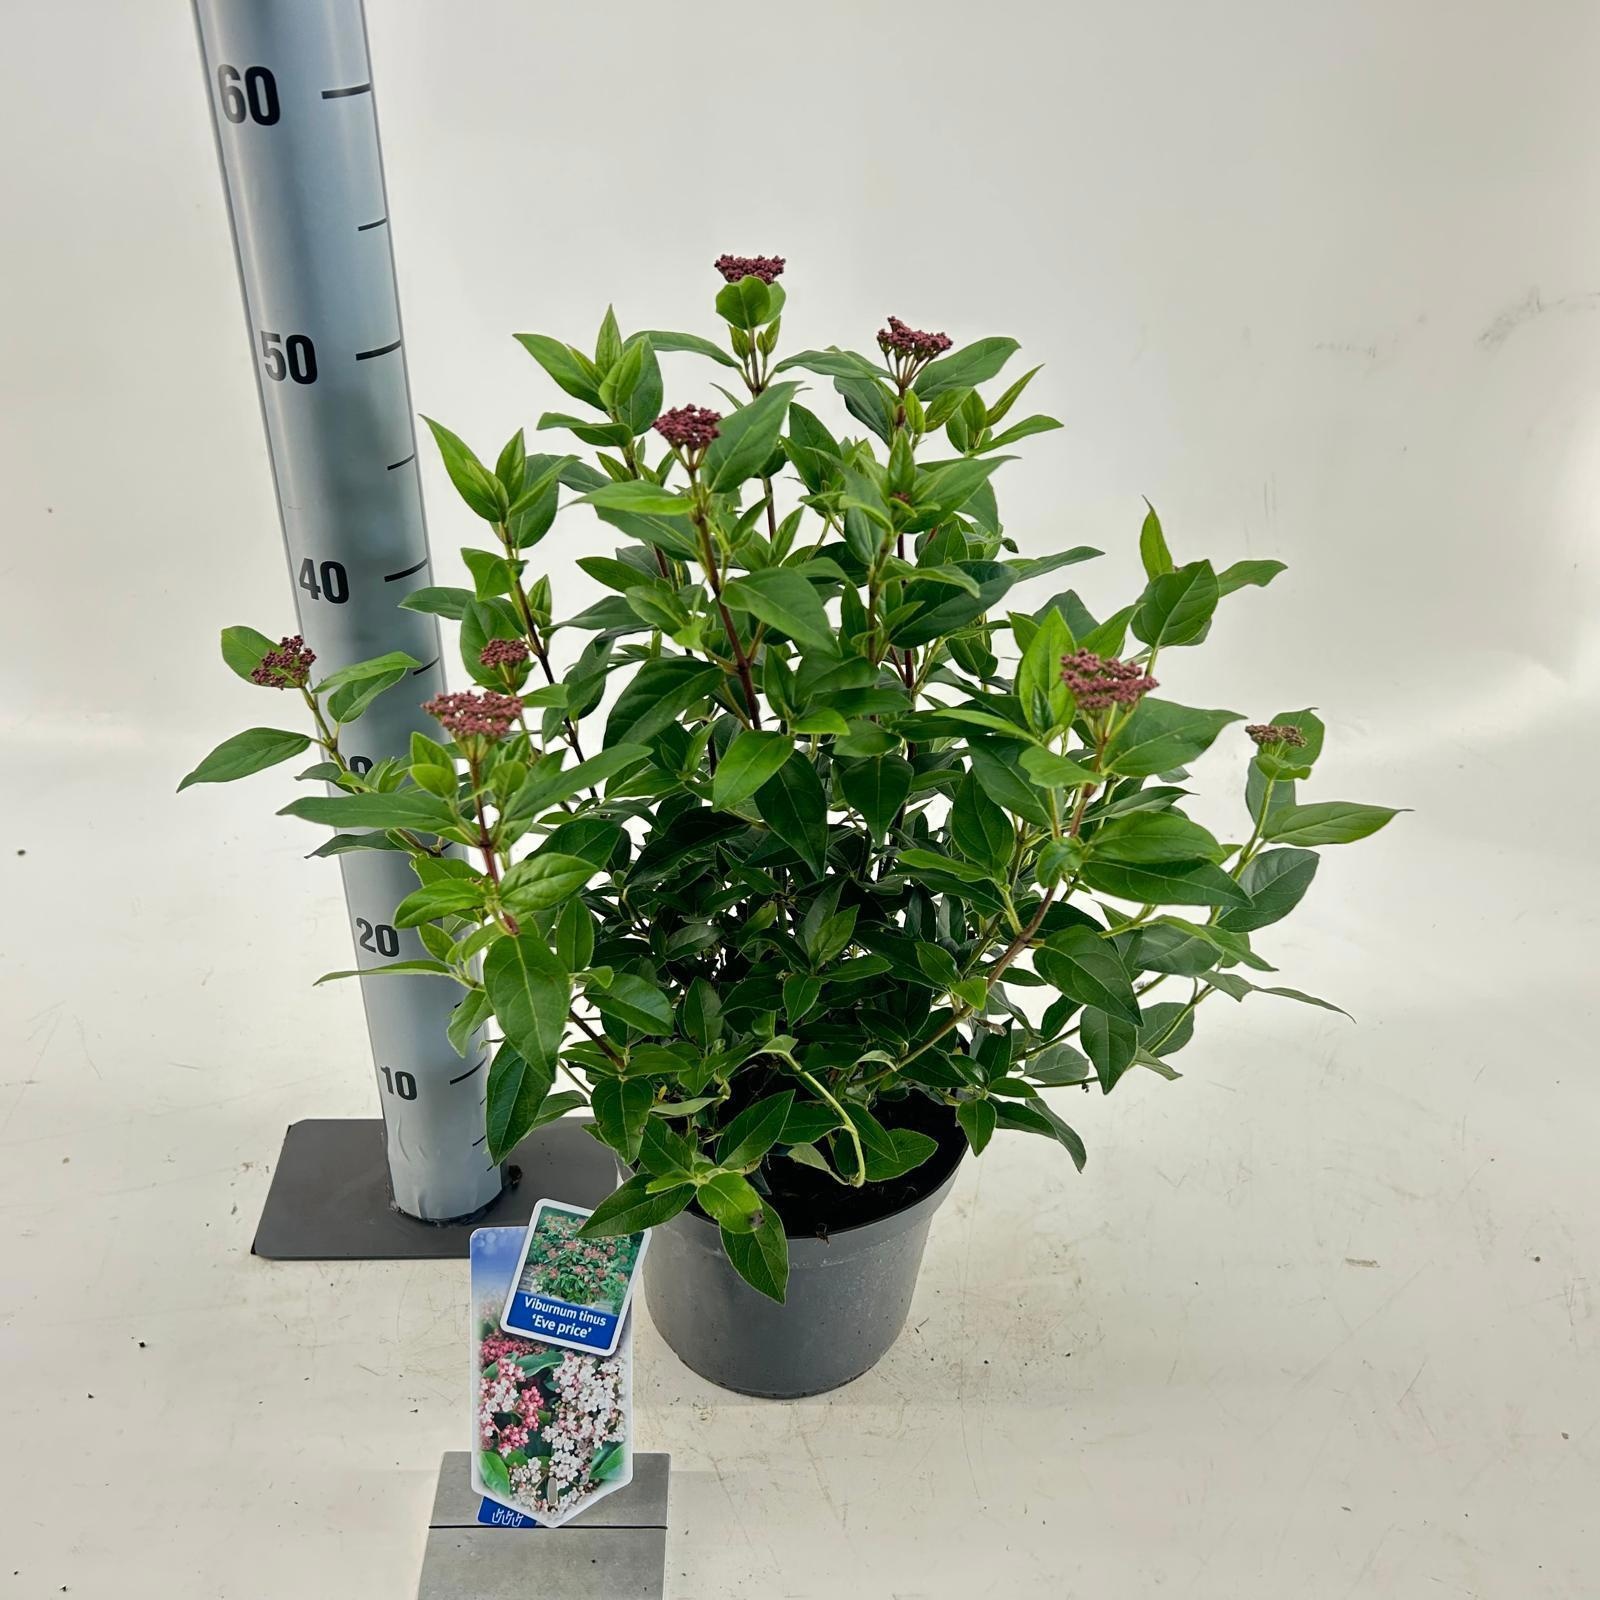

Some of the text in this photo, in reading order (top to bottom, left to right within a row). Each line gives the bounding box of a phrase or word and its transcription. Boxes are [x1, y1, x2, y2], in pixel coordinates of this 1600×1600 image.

[217, 64, 280, 126] 60
[260, 331, 318, 385] 50
[299, 558, 349, 604] 40
[356, 917, 399, 957] 20
[380, 1066, 417, 1100] 10
[525, 1296, 607, 1326] Viburnum tinus
